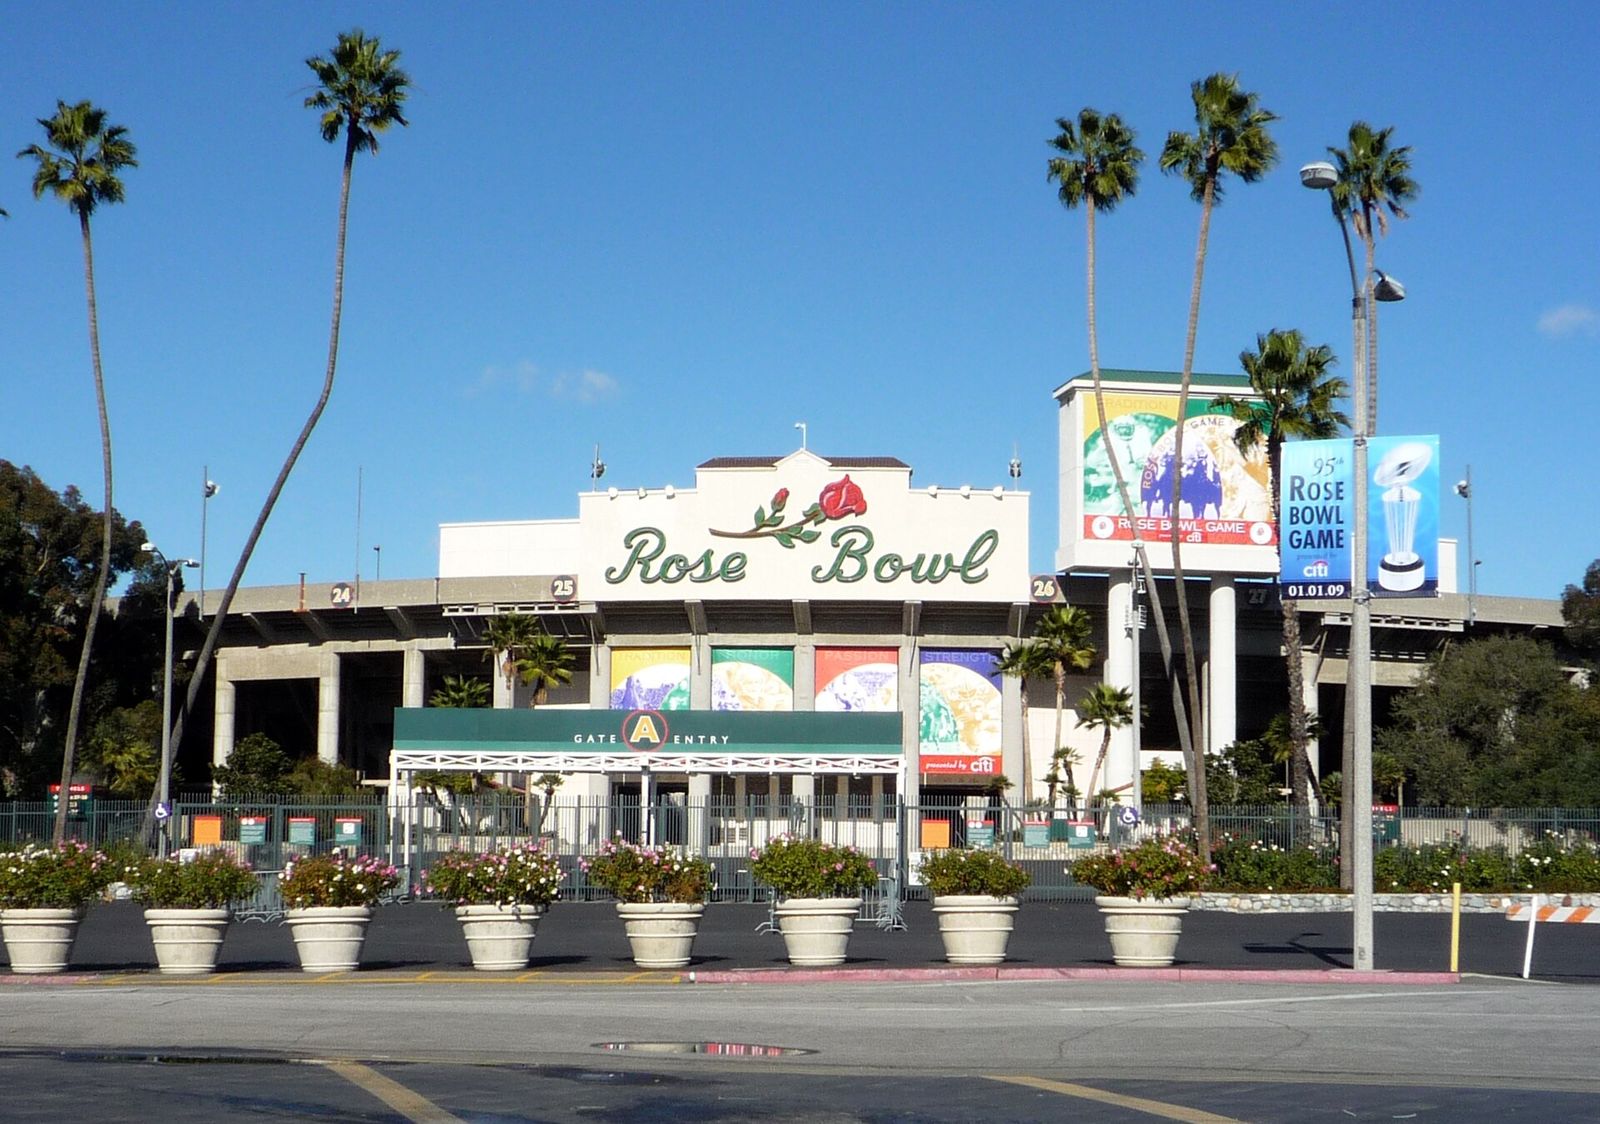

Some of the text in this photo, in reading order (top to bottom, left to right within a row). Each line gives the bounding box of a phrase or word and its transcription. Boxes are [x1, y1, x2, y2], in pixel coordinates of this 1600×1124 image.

[1191, 417, 1225, 429] GAME
[1290, 505, 1344, 525] BOWL
[1206, 522, 1246, 534] GAME
[1289, 529, 1344, 549] GAME
[605, 525, 999, 584] Rose Bowl
[1303, 562, 1329, 577] citi
[332, 587, 351, 603] 24
[553, 580, 574, 596] 25
[1033, 580, 1055, 597] 26
[1249, 588, 1268, 604] 27
[1288, 585, 1345, 597] 01.01.09
[574, 715, 729, 745] GATE A ENTRY
[970, 757, 994, 773] citi
